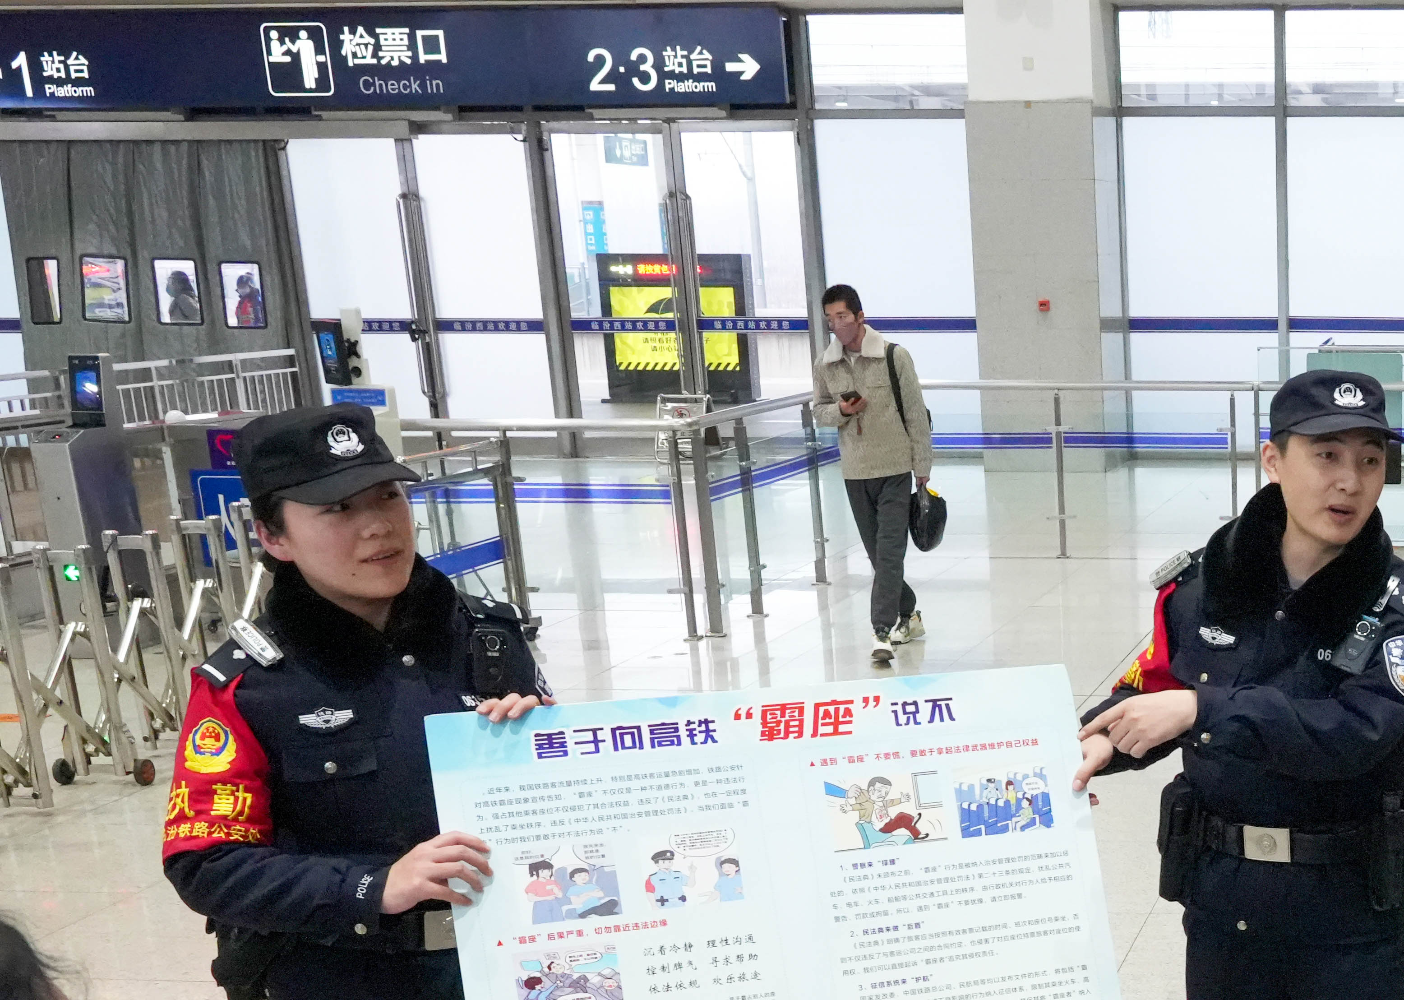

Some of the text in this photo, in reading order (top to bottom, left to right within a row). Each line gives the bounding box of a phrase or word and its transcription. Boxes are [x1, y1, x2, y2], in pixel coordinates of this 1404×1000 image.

[340, 26, 449, 67] 检票口
[40, 51, 90, 80] 站台
[663, 45, 713, 75] 站台
[45, 84, 95, 98] Platform
[359, 76, 445, 95] Check in
[665, 79, 717, 94] Platform
[453, 321, 529, 331] 临汾西站欢迎您
[591, 320, 668, 331] 临汾西站欢迎您
[713, 320, 790, 330] 临汾西站欢迎您
[1317, 648, 1332, 661] 06
[533, 695, 957, 761] 善于向高铁“霸座”说不
[165, 780, 253, 822] 执勤
[162, 821, 262, 843] 汾铁路公安处
[641, 932, 757, 958] 沉着冷静 理性沟通
[707, 950, 759, 968] 寻求帮助
[647, 969, 762, 995] 依法依规 欢乐旅途
